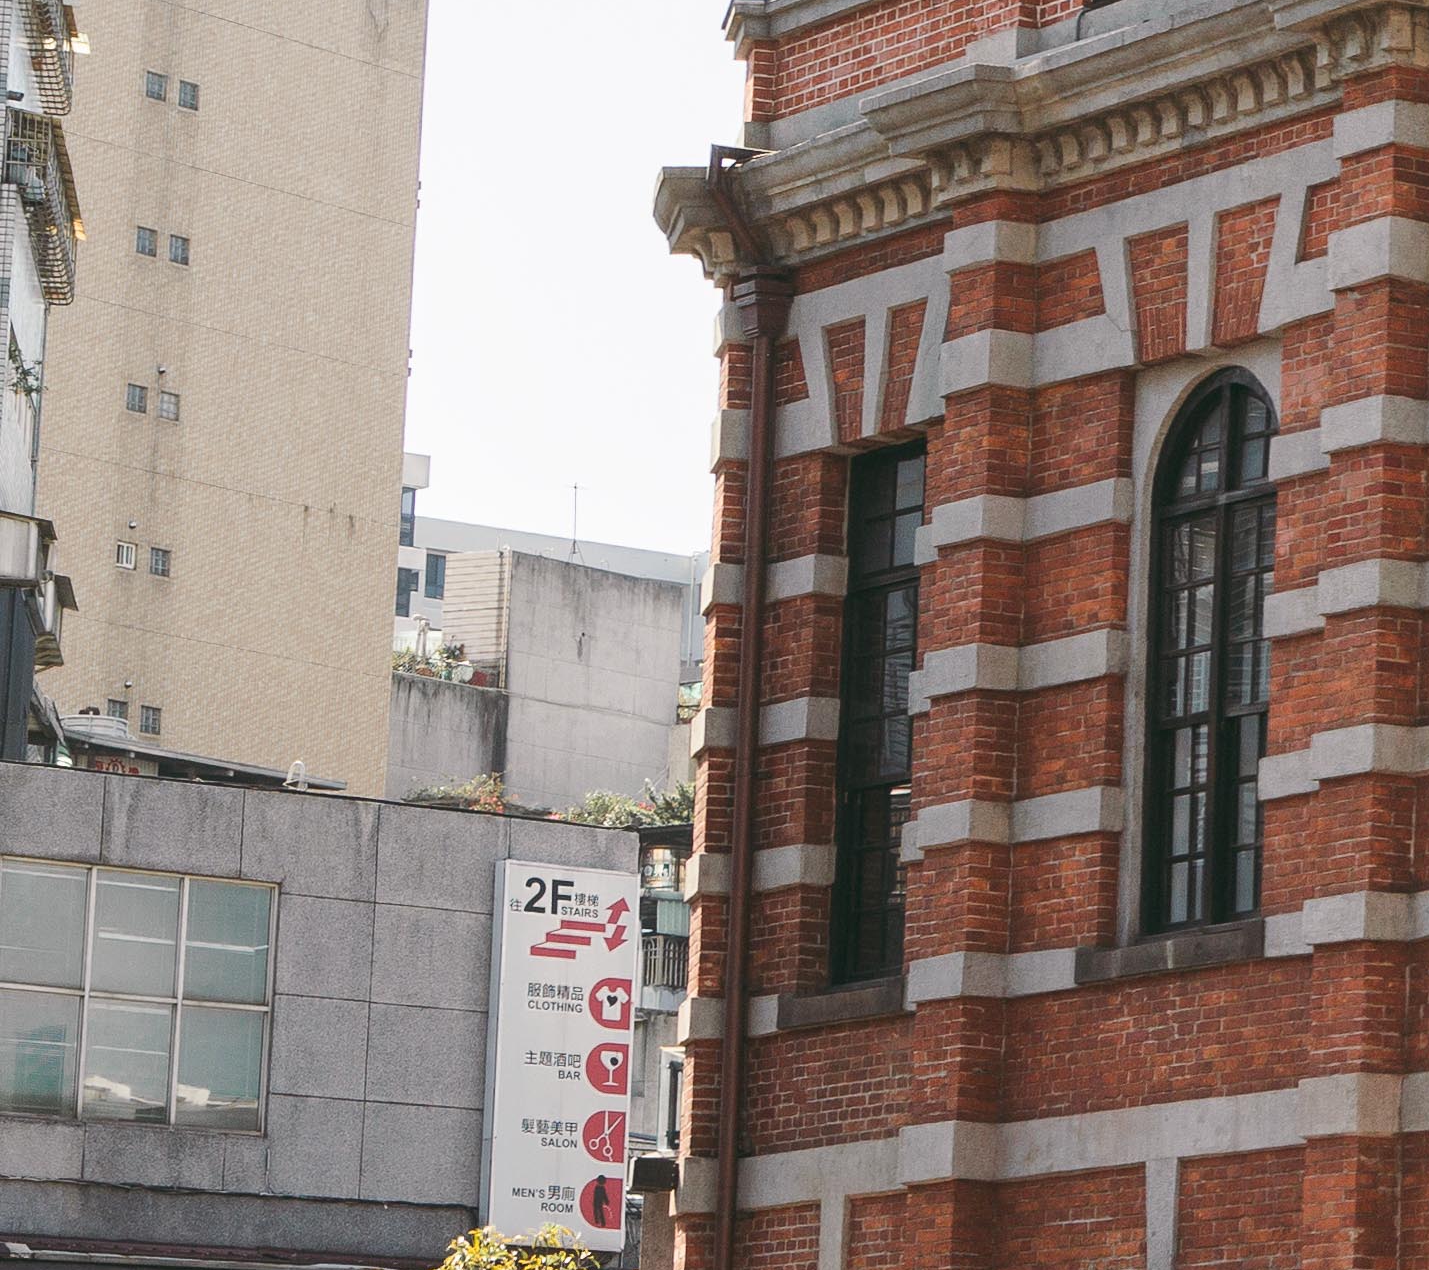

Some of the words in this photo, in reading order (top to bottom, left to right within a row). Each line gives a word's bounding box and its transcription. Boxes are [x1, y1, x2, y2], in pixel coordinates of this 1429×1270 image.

[523, 876, 575, 915] 2F
[574, 892, 600, 907] 樓梯
[561, 906, 599, 918] STAIRS
[527, 982, 584, 1001] 服飾精品
[527, 1000, 583, 1013] CLOTHING
[524, 1050, 582, 1069] 主題酒吧
[558, 1070, 581, 1081] BAR
[521, 1118, 578, 1136] 髮藝美甲
[541, 1137, 578, 1149] SALON
[512, 1187, 545, 1199] MEN'S
[541, 1203, 574, 1213] ROOM
